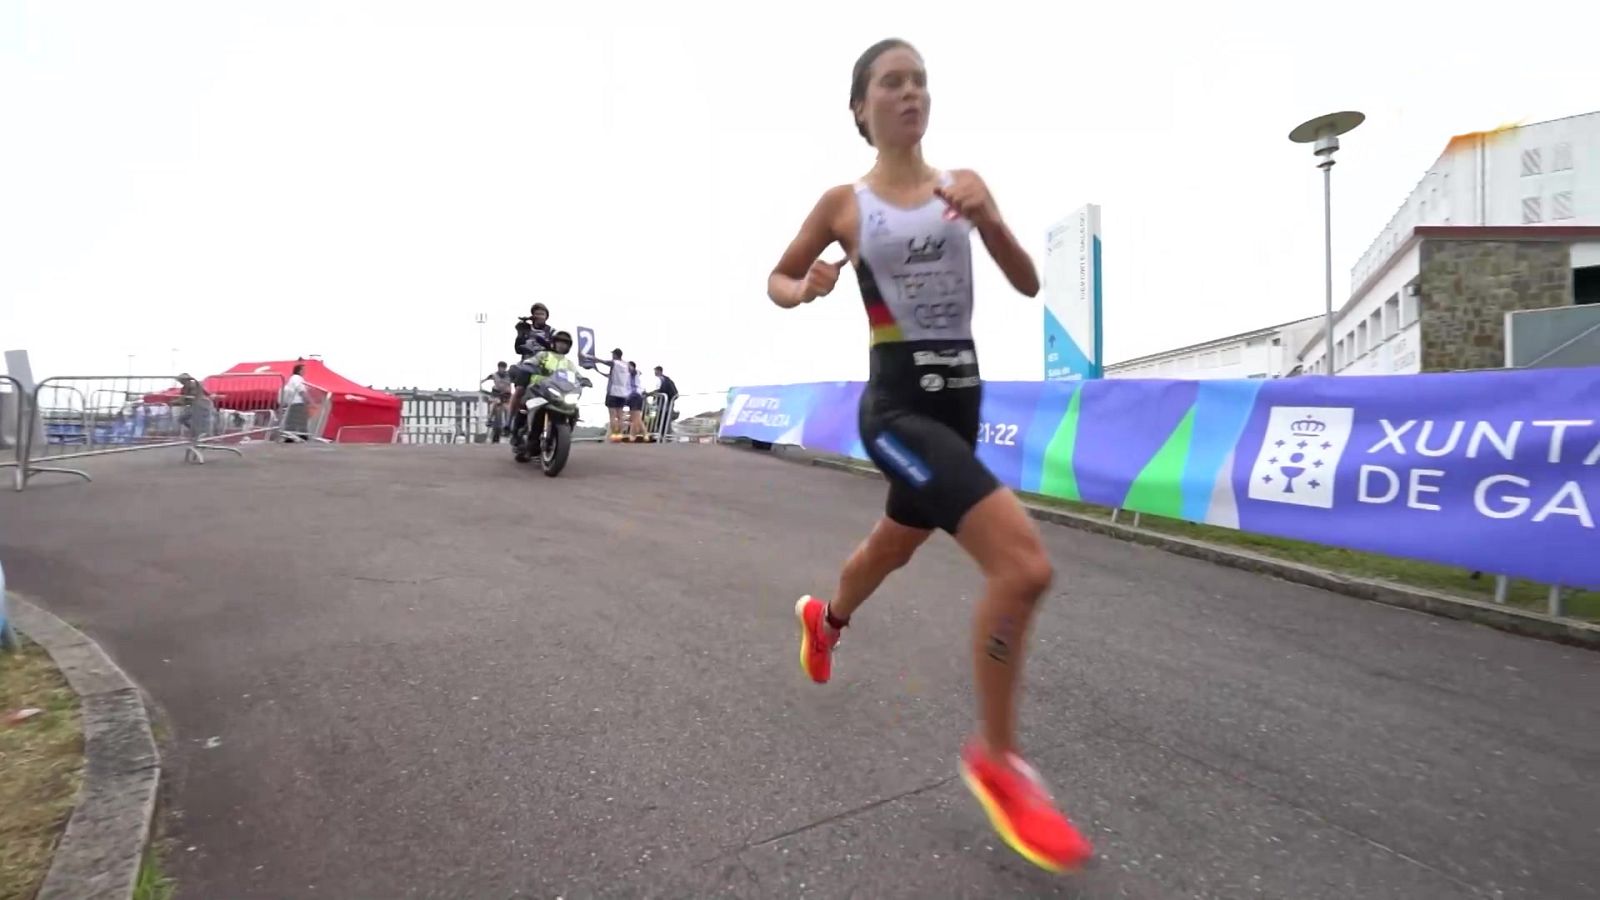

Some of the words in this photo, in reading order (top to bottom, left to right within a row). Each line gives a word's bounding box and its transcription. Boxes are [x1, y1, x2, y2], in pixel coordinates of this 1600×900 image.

[579, 330, 593, 358] 2
[1357, 464, 1447, 512] DE
[1473, 474, 1595, 529] GA
